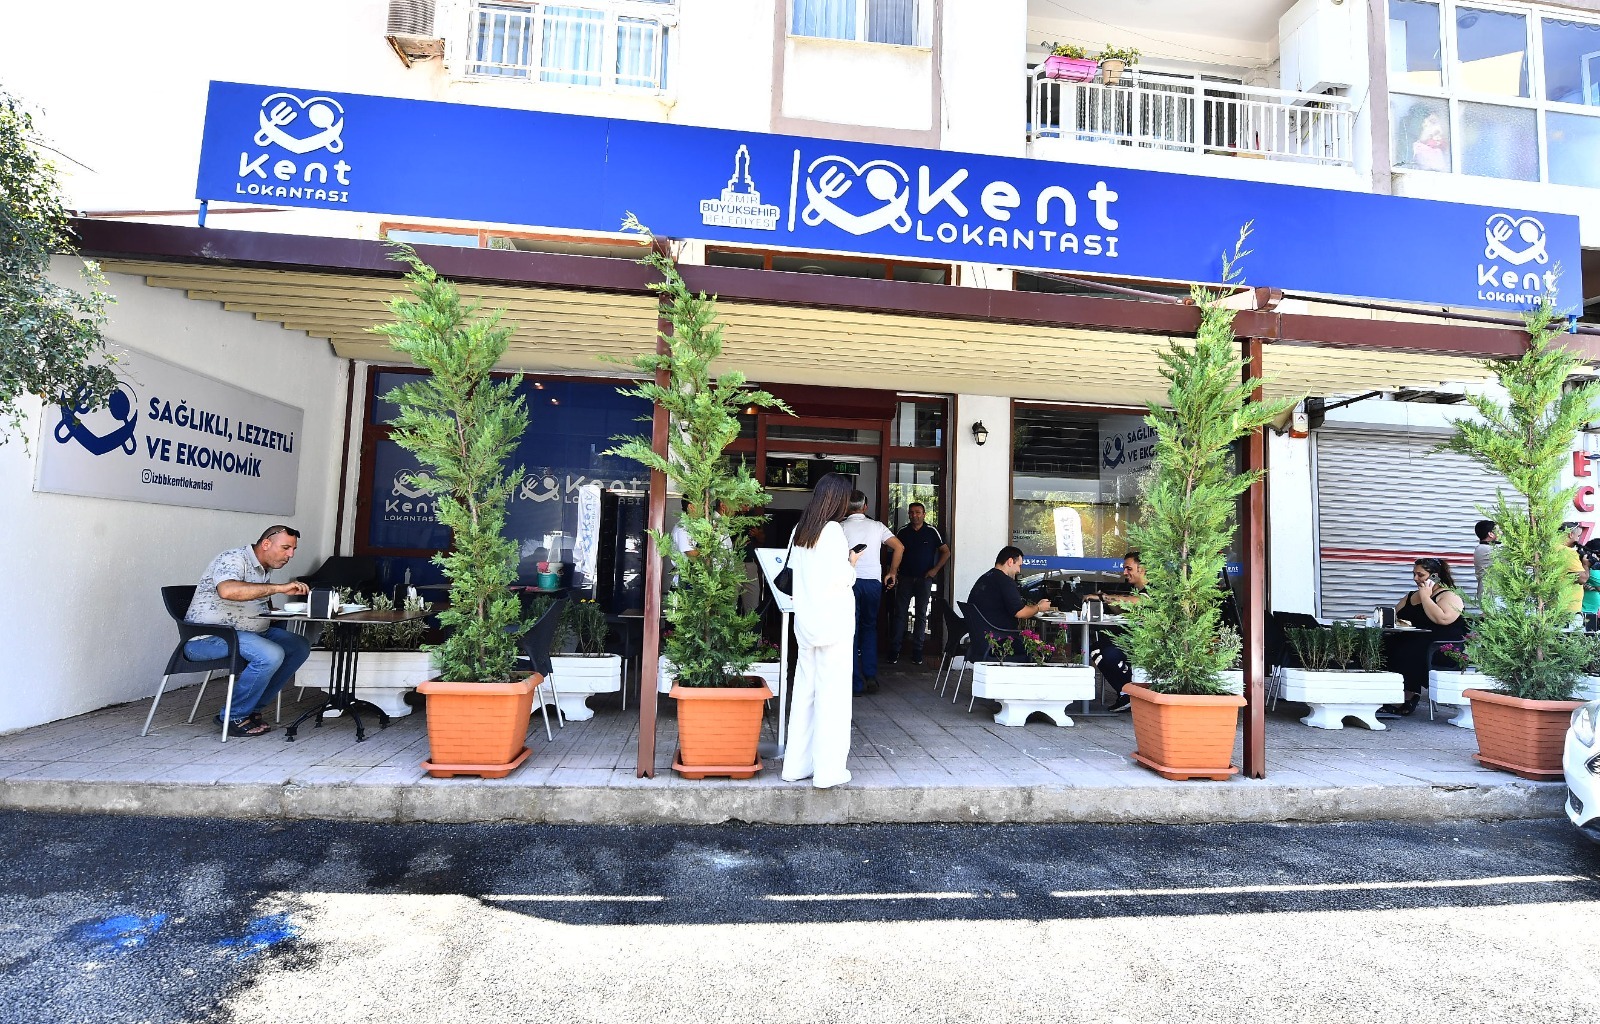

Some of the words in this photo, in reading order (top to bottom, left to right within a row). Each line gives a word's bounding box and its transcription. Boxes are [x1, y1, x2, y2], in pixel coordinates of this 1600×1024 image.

[239, 152, 351, 185] Kent
[236, 182, 348, 202] LOKANTASI
[918, 165, 1118, 230] Kent
[917, 220, 1118, 257] LOKANTASI
[1477, 264, 1556, 292] Kent
[1477, 290, 1557, 306] LOKANTAI
[148, 397, 233, 442] SAĞLIKLI,
[237, 421, 294, 453] LEZZETLİ
[1127, 426, 1158, 443] SAĞLIK
[146, 435, 172, 462] VE
[176, 442, 262, 477] EKONOMİK
[1127, 450, 1138, 462] VE
[1139, 444, 1158, 460] EKO
[385, 499, 440, 512] Kent
